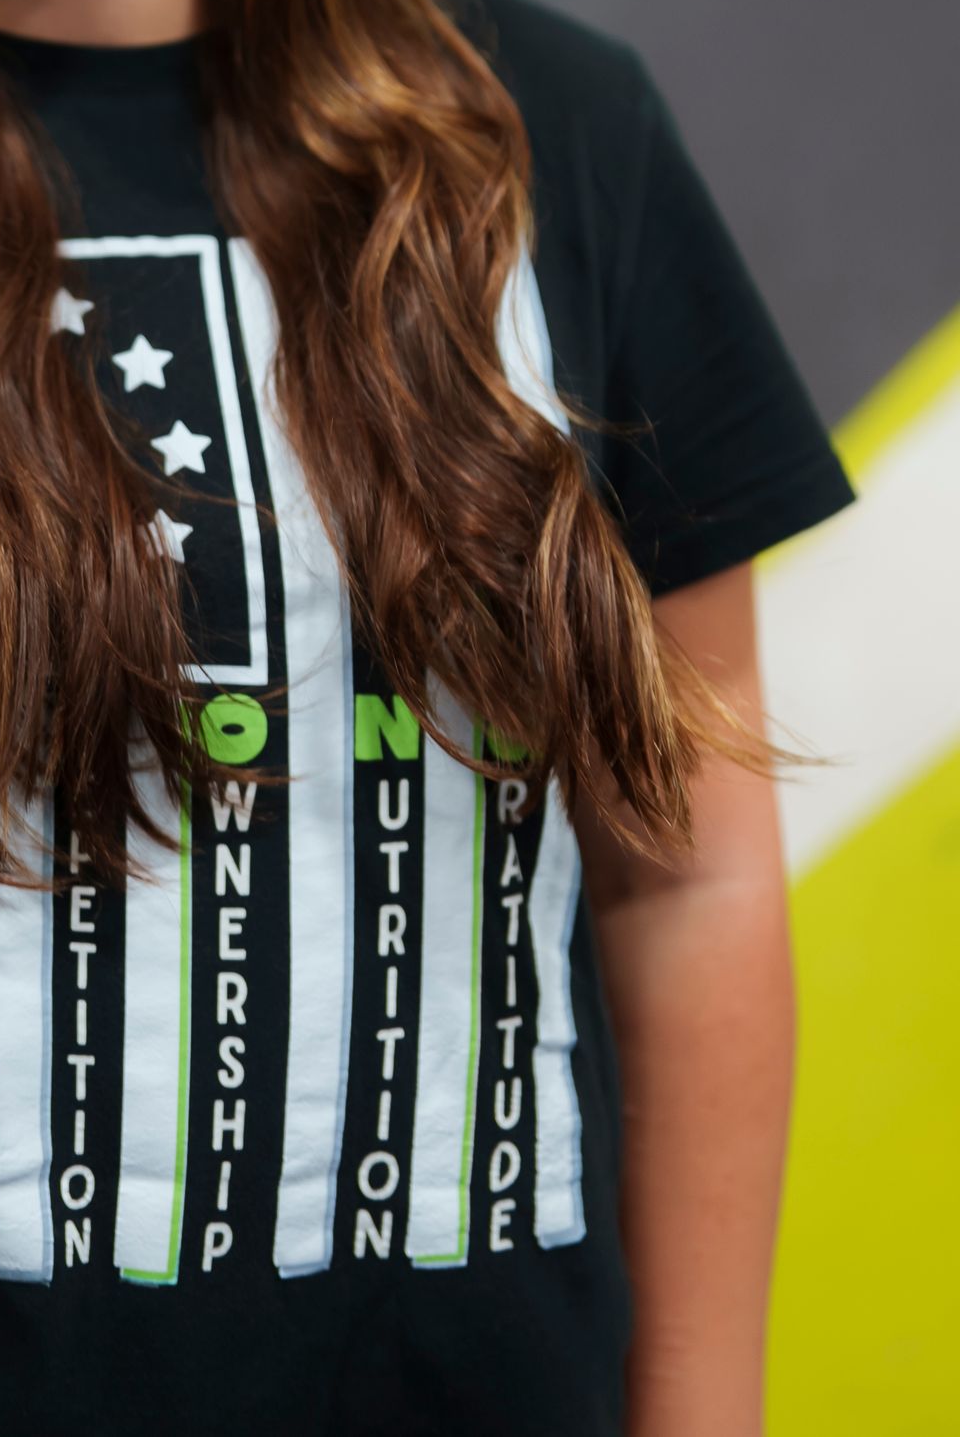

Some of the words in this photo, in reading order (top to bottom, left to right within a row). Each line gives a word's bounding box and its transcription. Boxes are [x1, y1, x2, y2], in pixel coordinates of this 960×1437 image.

[57, 828, 98, 1268] ETITION
[199, 692, 269, 1272] OWNERSHIP
[352, 692, 422, 1260] NUTRITION
